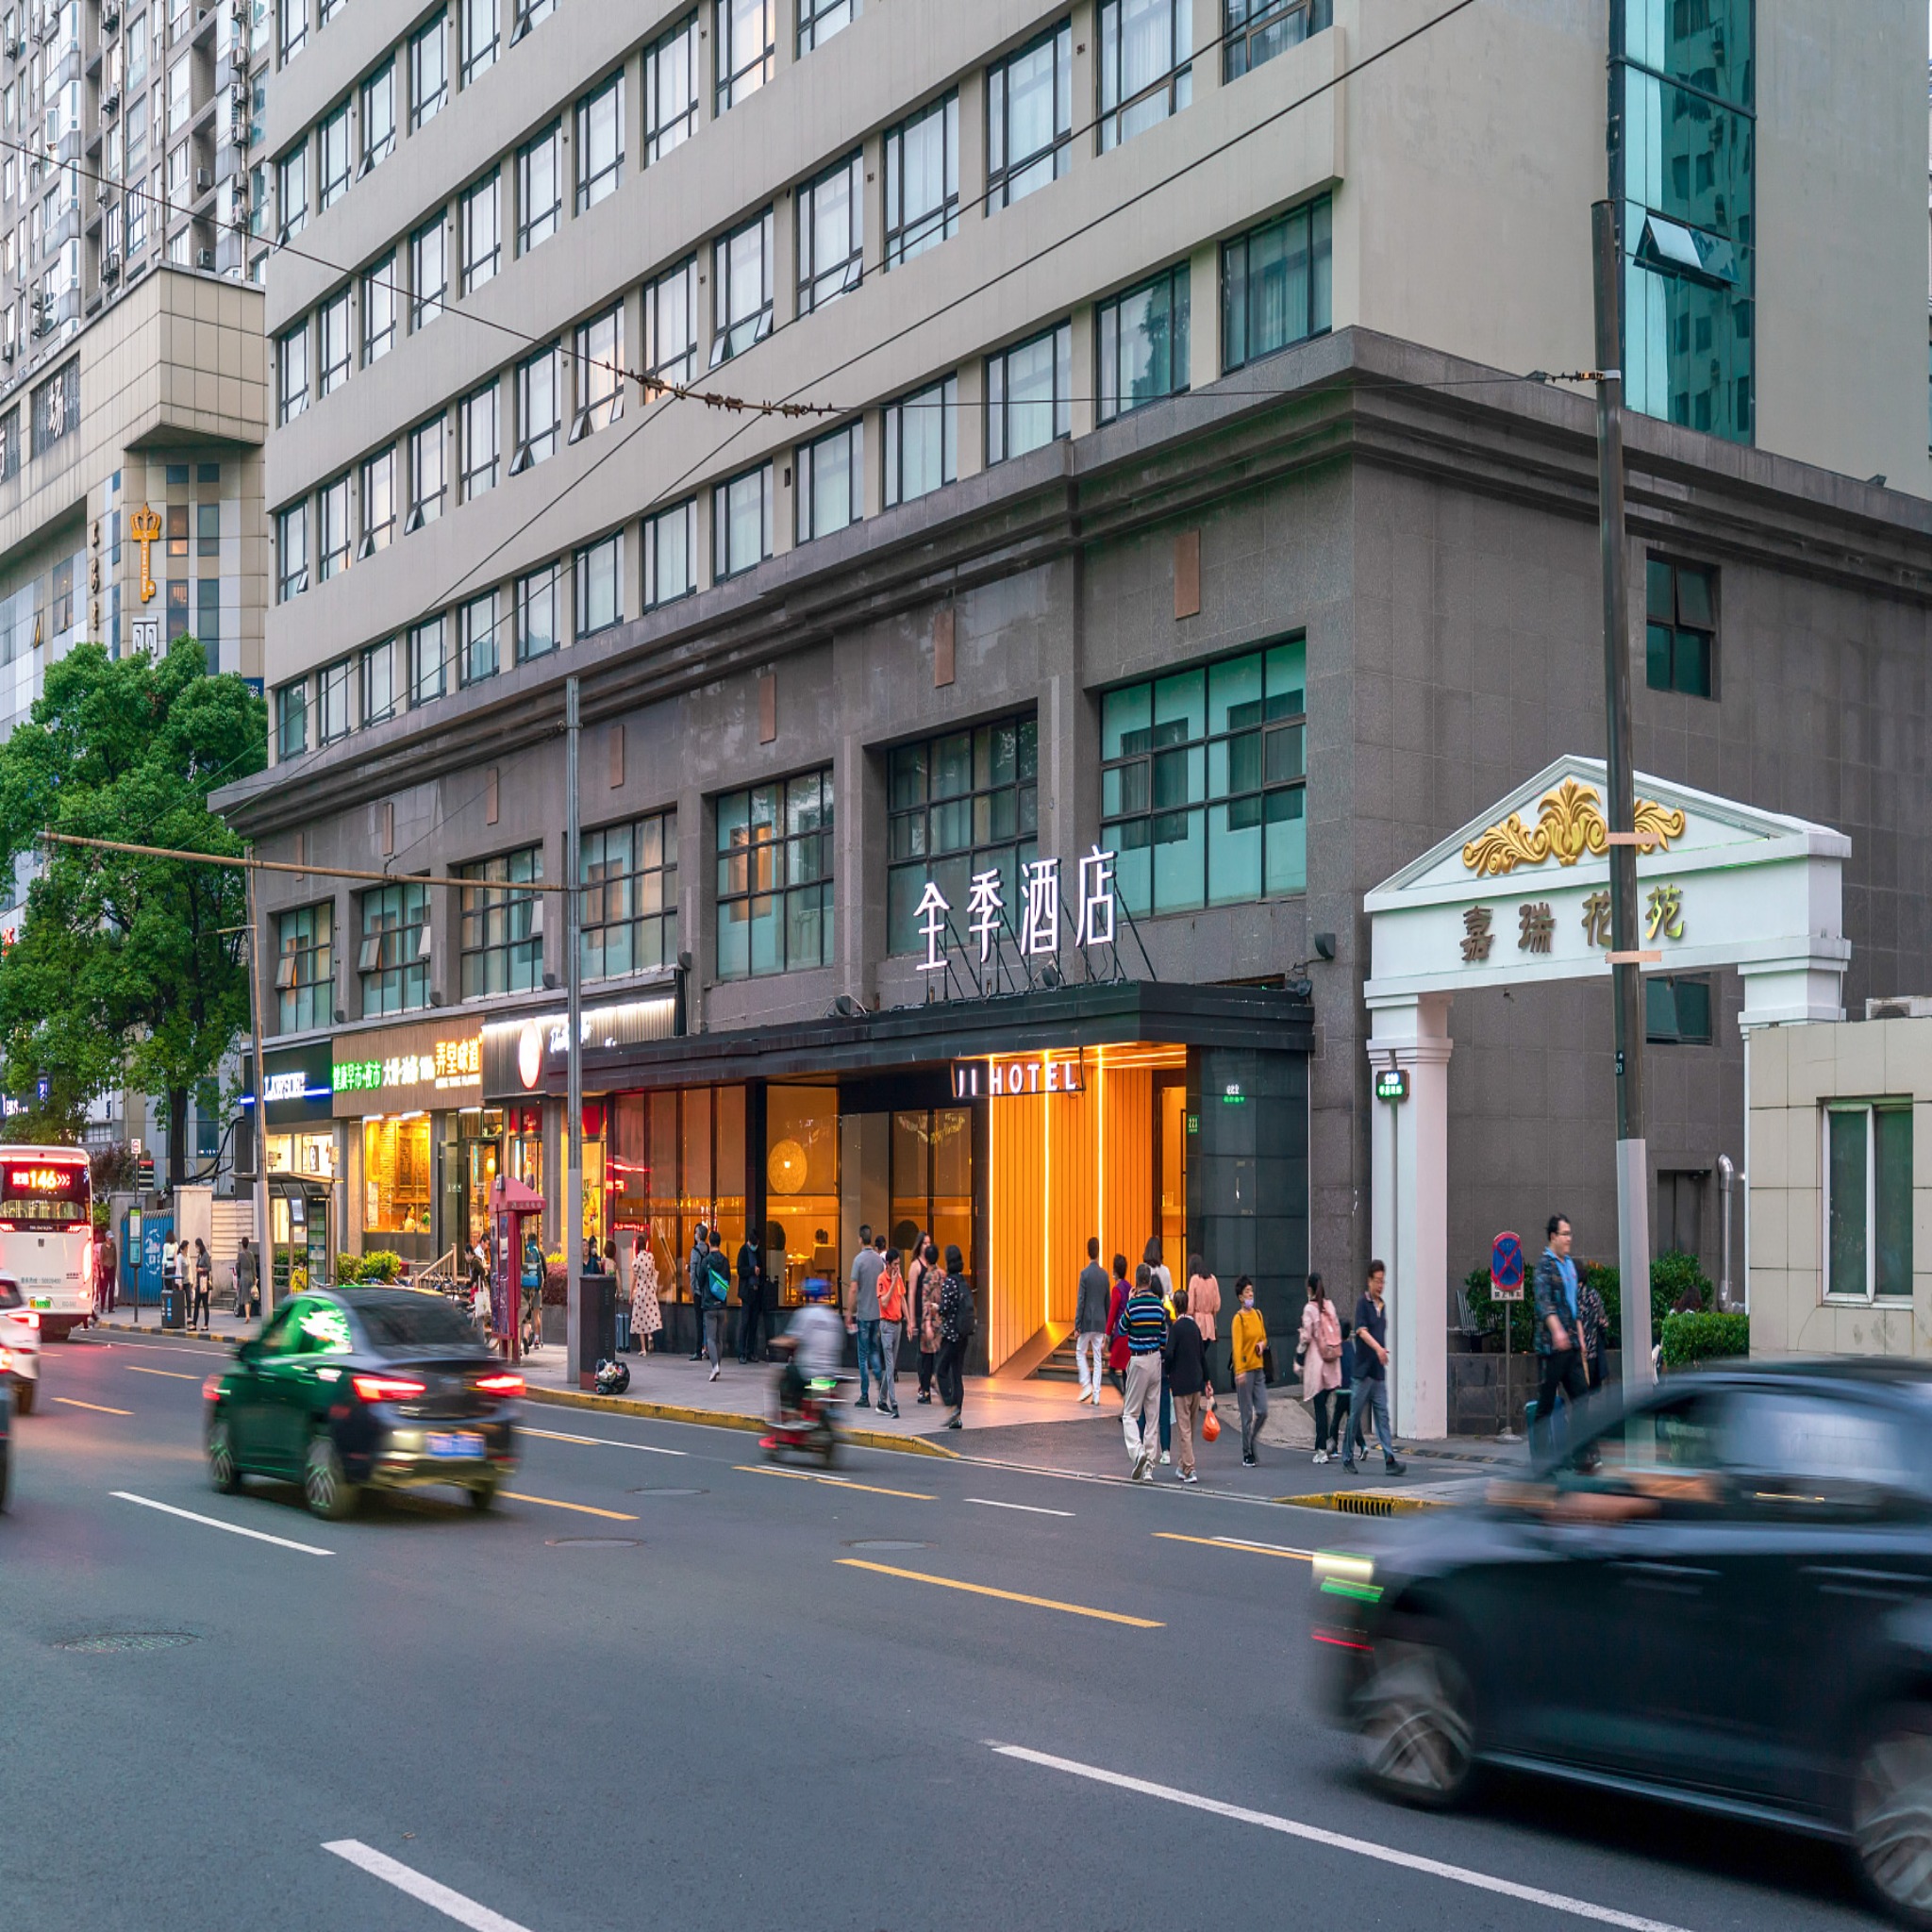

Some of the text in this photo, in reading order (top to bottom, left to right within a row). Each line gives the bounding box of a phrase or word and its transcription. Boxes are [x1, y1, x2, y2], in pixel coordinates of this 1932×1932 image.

[913, 844, 1118, 971] 全季酒店
[1459, 883, 1686, 961] 嘉瑞花苑
[958, 1061, 1078, 1097] JI HOTEL
[30, 1170, 57, 1189] 146
